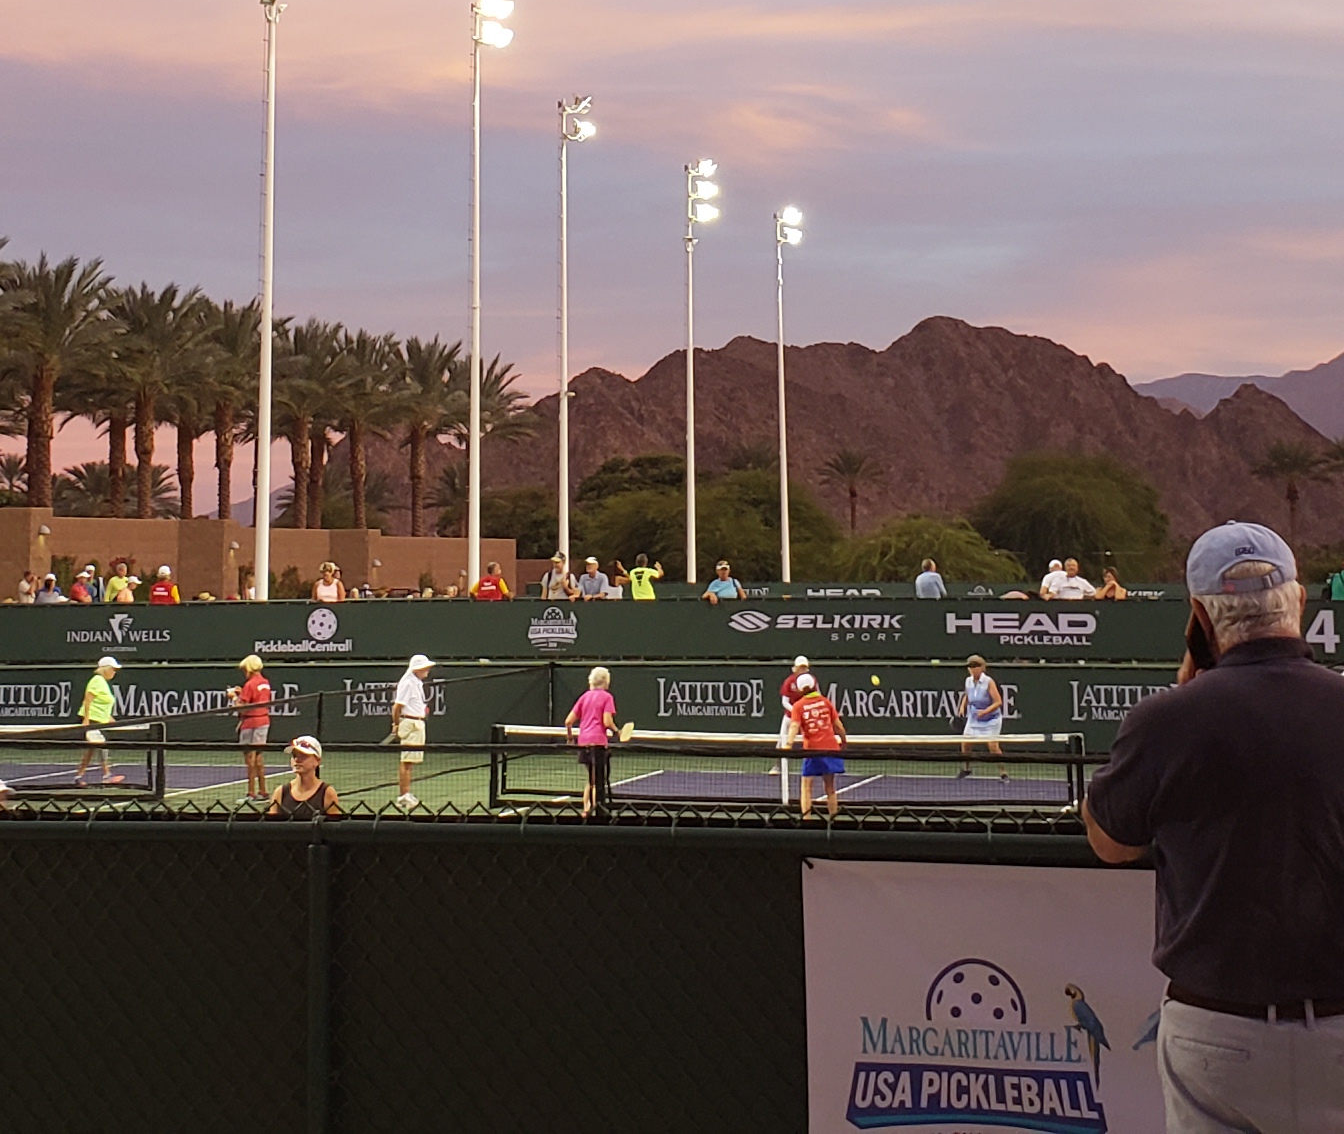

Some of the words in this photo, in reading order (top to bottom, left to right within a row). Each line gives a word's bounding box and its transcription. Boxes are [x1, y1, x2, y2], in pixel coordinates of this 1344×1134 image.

[775, 614, 905, 629] SELKIRK
[946, 612, 1097, 635] HEAD
[1305, 609, 1341, 654] 4
[66, 631, 112, 642] INDIAN
[129, 630, 171, 642] WELLS
[830, 632, 901, 641] SPORT
[999, 635, 1092, 646] PICKLEBALL
[656, 677, 765, 717] LATITUDE
[860, 1016, 1085, 1063] MARGARITAVILLE
[855, 1071, 913, 1109] USA
[920, 1071, 1101, 1120] PICKLEBALL
